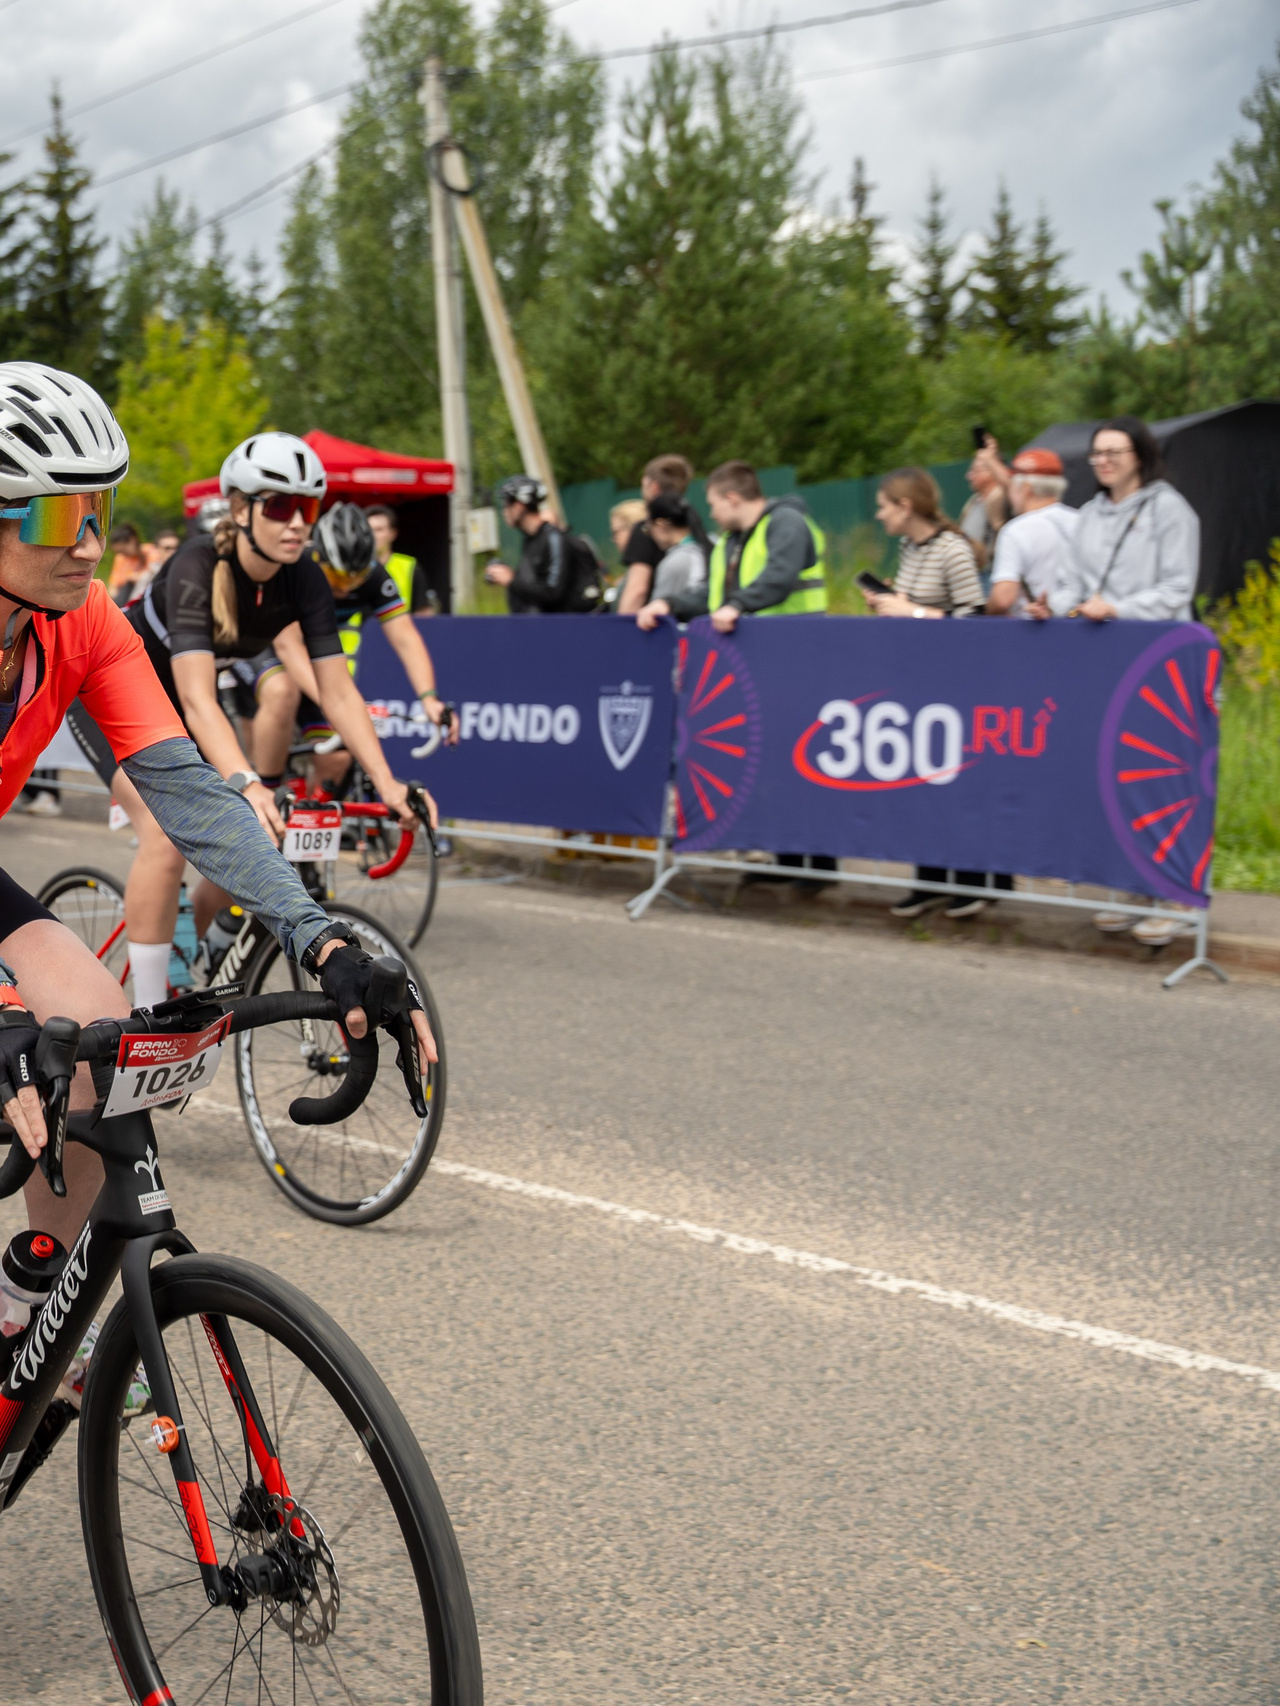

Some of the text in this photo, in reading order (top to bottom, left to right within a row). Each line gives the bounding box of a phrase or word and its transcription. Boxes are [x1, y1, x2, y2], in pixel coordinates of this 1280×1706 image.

[461, 701, 581, 745] FONDO
[295, 831, 333, 850] 1089
[209, 918, 256, 989] MC
[214, 986, 240, 997] GARMIN
[129, 1048, 178, 1058] FONDO
[133, 1040, 172, 1049] GRAN
[19, 1053, 30, 1083] GIRO
[132, 1052, 207, 1099] 1026
[55, 1116, 65, 1163] 105
